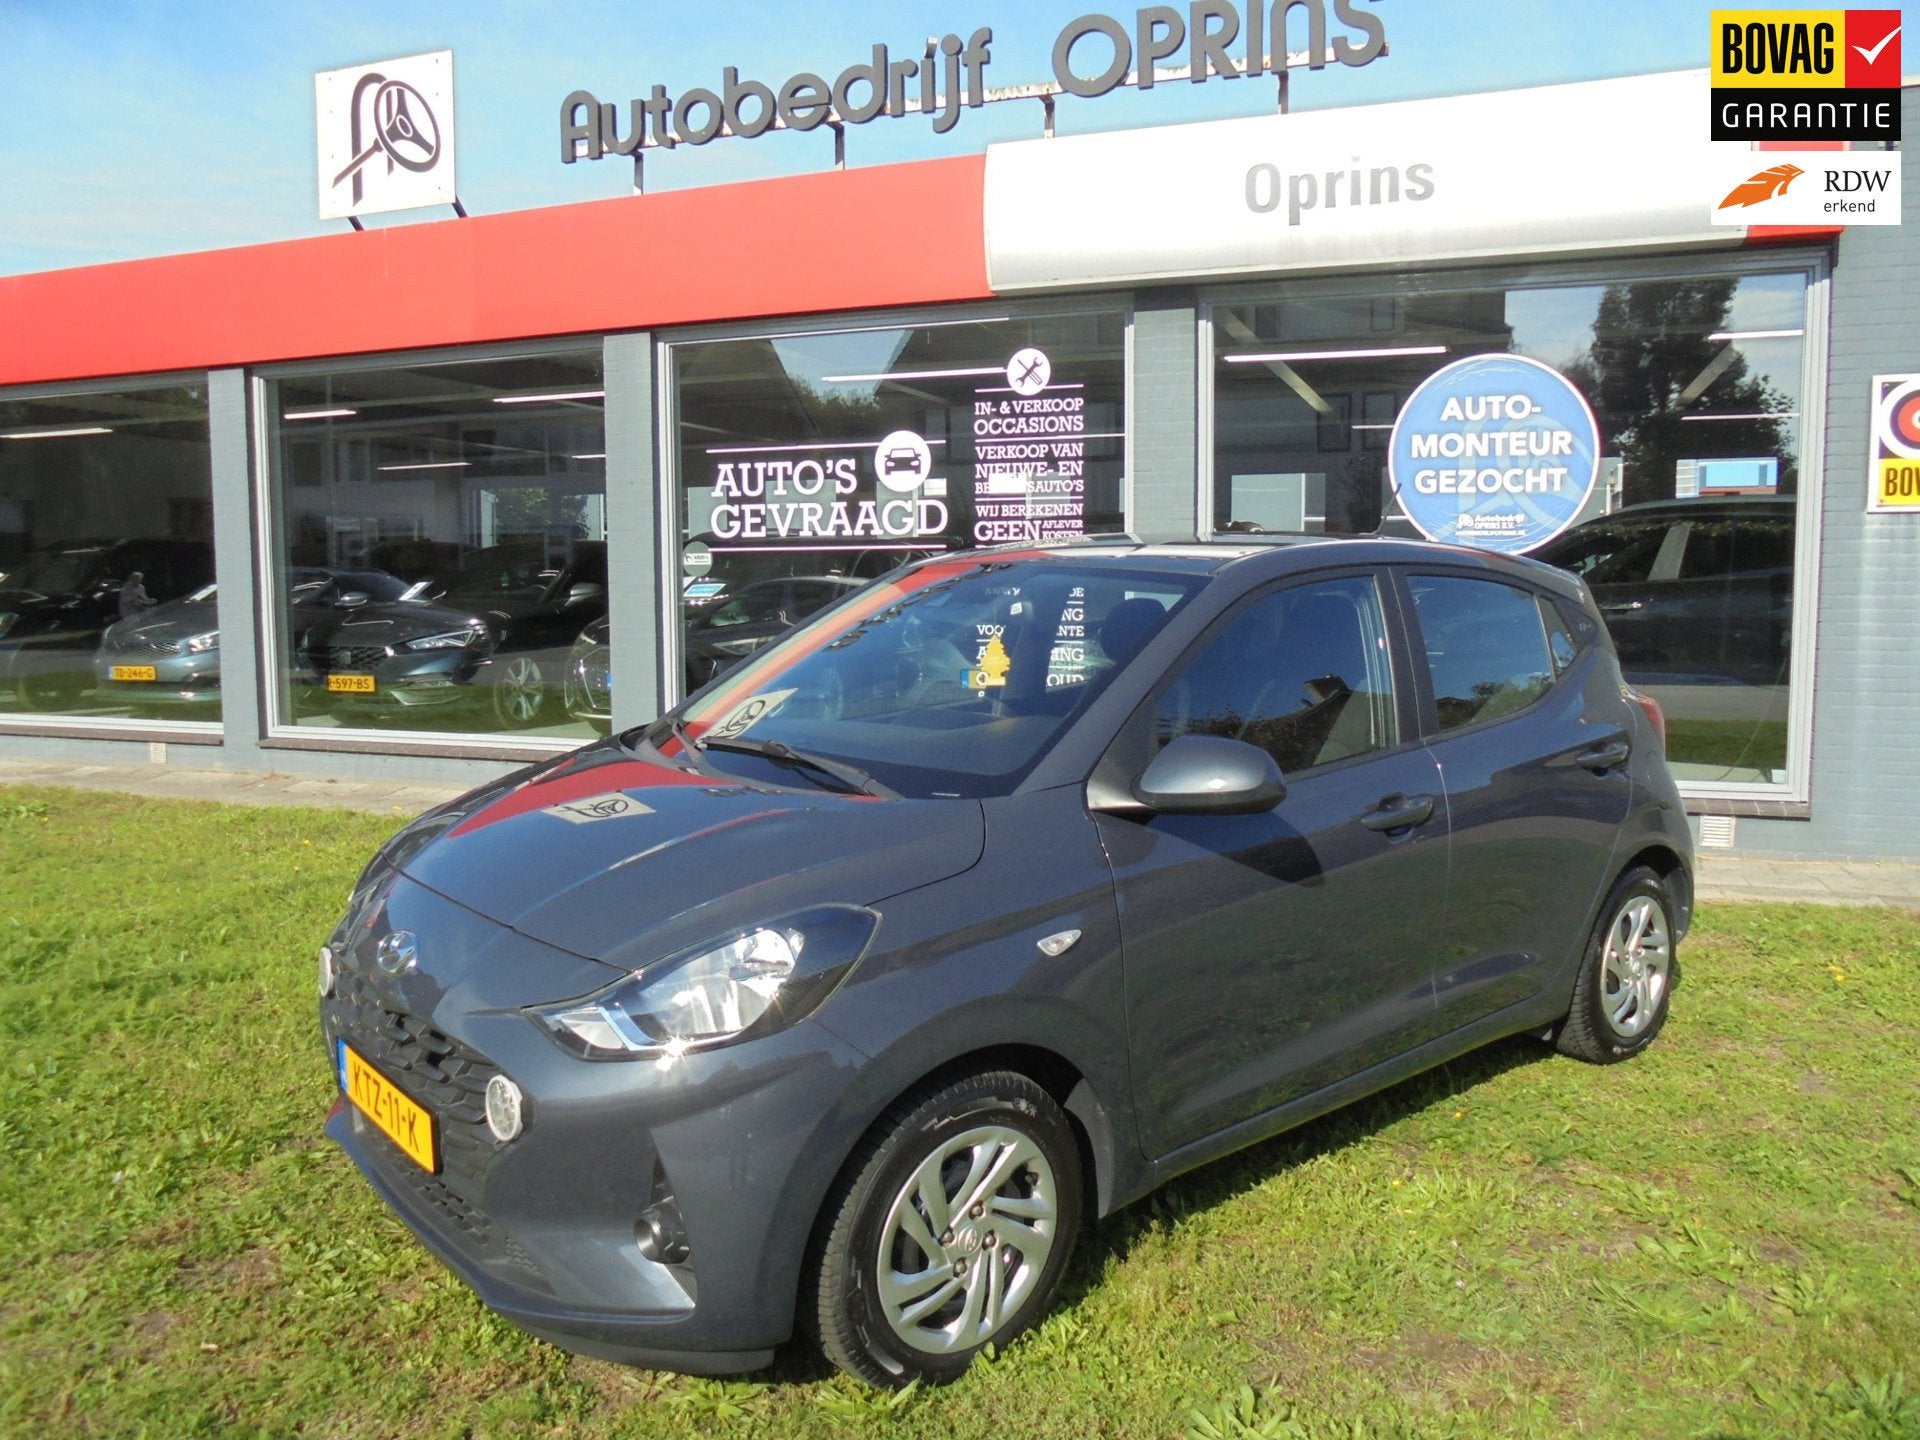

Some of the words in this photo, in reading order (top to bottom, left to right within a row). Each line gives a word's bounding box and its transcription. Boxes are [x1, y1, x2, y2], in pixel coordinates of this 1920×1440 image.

[560, 26, 992, 164] Autobedrijf
[1052, 0, 1385, 98] OPRINS
[1245, 156, 1435, 226] Oprins
[975, 402, 996, 415] IN-
[1000, 401, 1011, 414] &
[1012, 398, 1084, 413] VERKOOP
[1440, 394, 1542, 421] AUTO-
[974, 415, 1084, 435] OCCASIONS
[975, 444, 1049, 460] VERKOOP
[1050, 443, 1084, 457] VAN
[1411, 430, 1573, 458] MONTEUR
[711, 458, 858, 498] AUTO'S
[1058, 461, 1084, 476] EN
[1414, 467, 1568, 494] GEZOCHT
[710, 500, 948, 539] GEVRAAGD
[975, 505, 999, 517] WIJ
[1001, 504, 1084, 517] BEREKENEN
[974, 520, 1042, 541] GEEN
[1042, 520, 1083, 529] AFLEVER
[353, 1060, 420, 1153] KTZ-11-K
